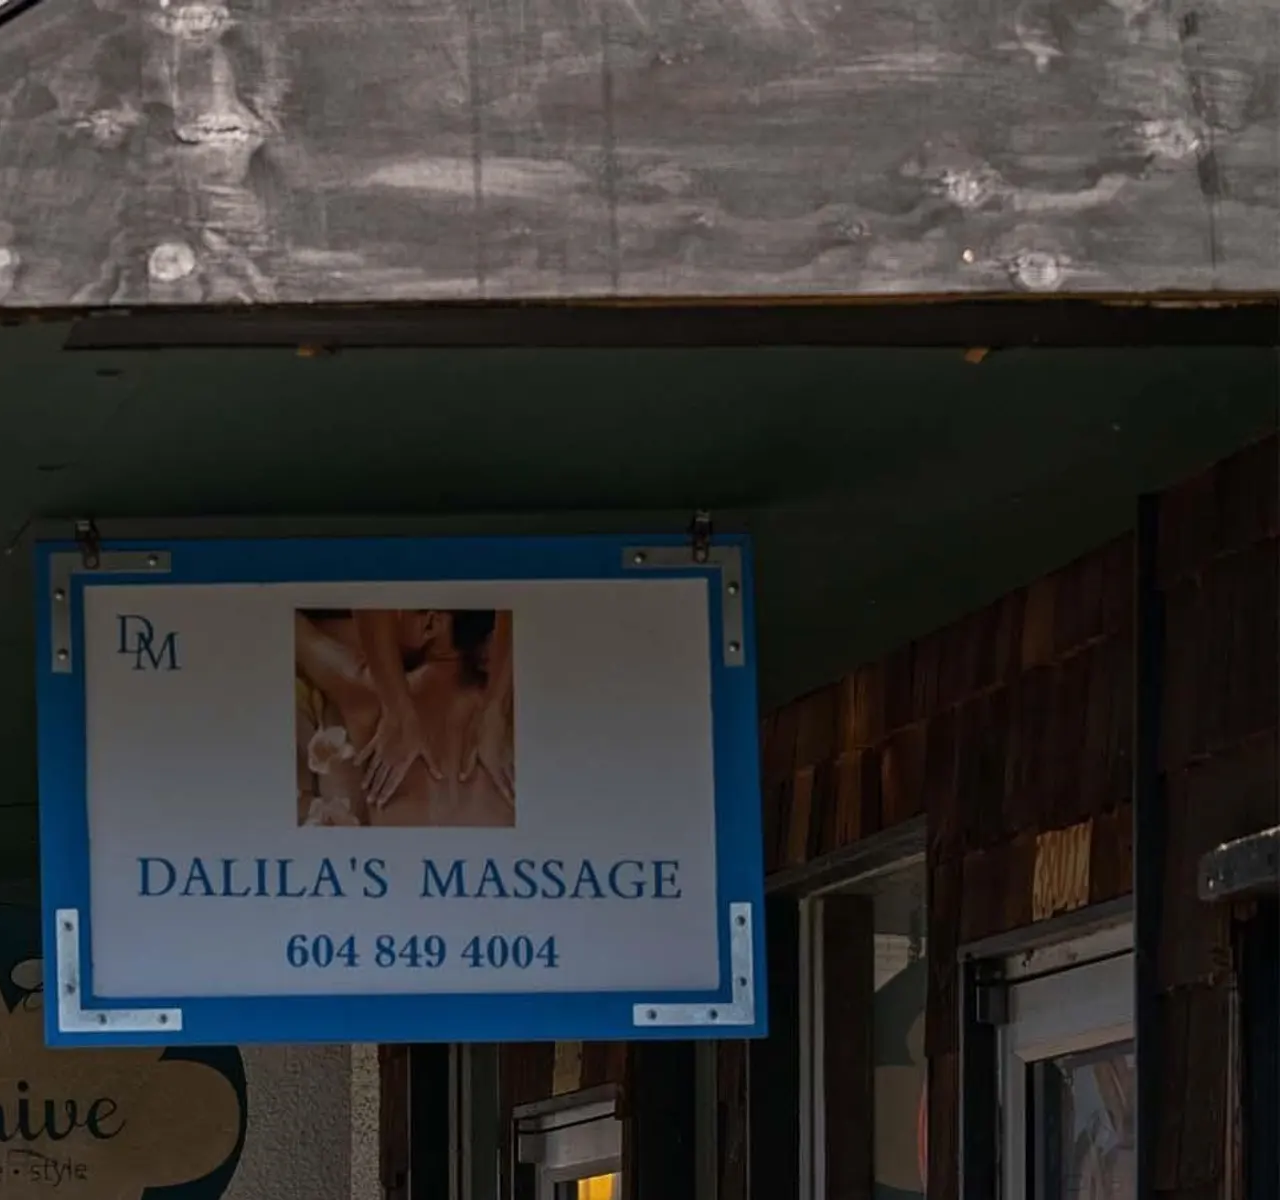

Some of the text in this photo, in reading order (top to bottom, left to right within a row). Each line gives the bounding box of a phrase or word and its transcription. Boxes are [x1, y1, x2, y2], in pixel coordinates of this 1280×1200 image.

[138, 857, 683, 900] DALILA'S MASSAGE
[285, 934, 561, 970] 604 849 4004
[19, 1152, 89, 1186] style
